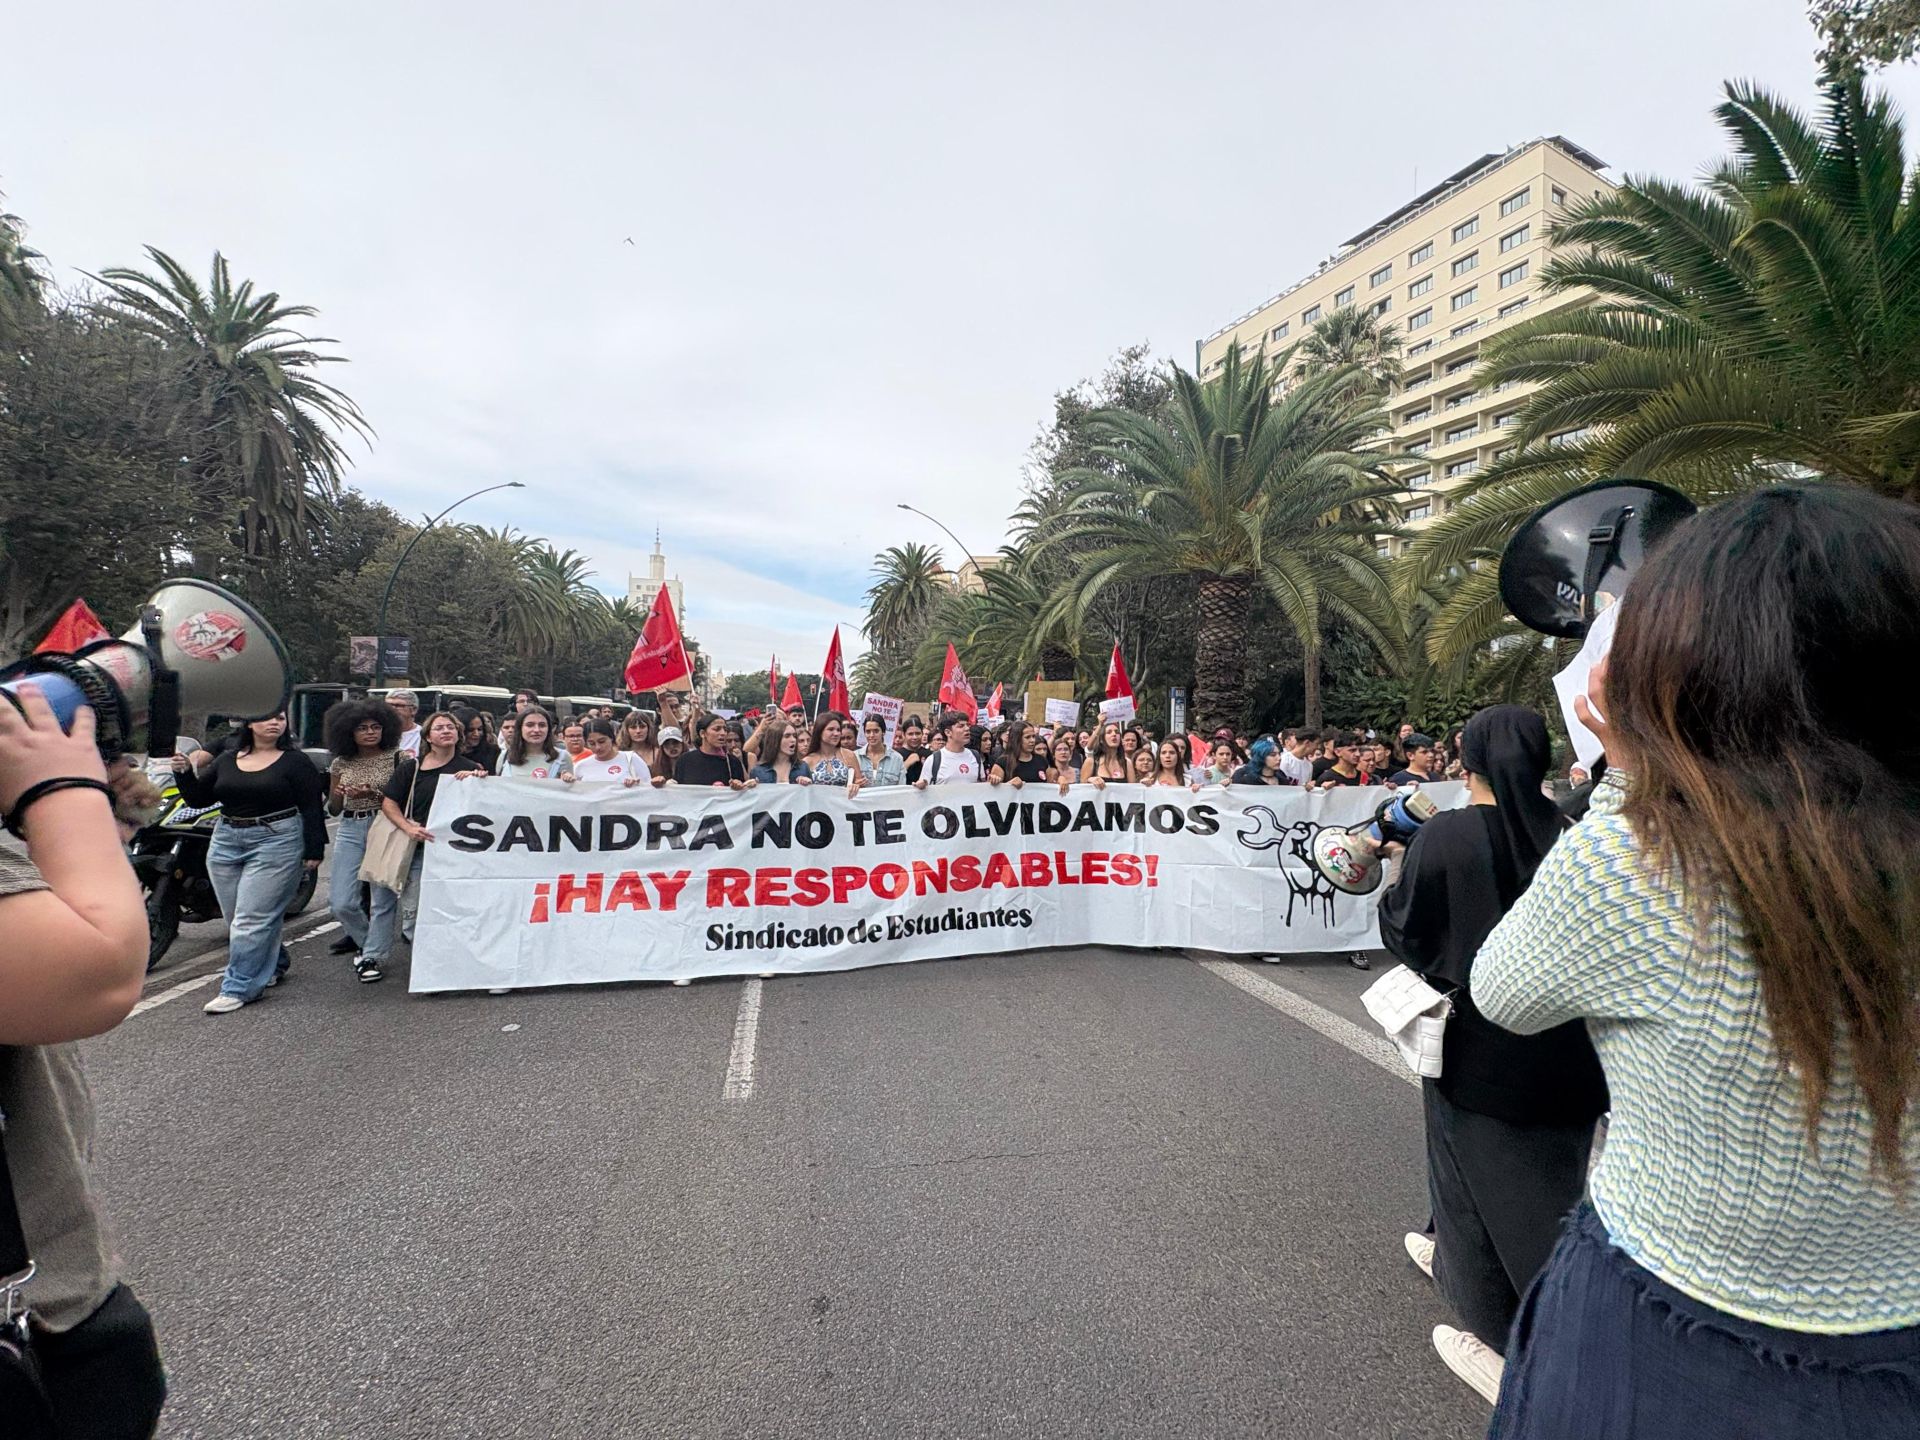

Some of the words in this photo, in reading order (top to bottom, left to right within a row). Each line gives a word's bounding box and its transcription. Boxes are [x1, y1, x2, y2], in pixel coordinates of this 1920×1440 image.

[867, 697, 898, 709] SANDRA
[447, 813, 736, 853] SANDRA
[750, 810, 836, 850] NO
[845, 809, 907, 847] TE
[920, 800, 1220, 840] OLVIDAMOS
[530, 869, 692, 923] ¡HAY
[706, 852, 1160, 908] RESPONSABLES!
[705, 922, 845, 952] Sindicato
[846, 918, 883, 946] de
[886, 907, 1033, 941] Estudiantes
